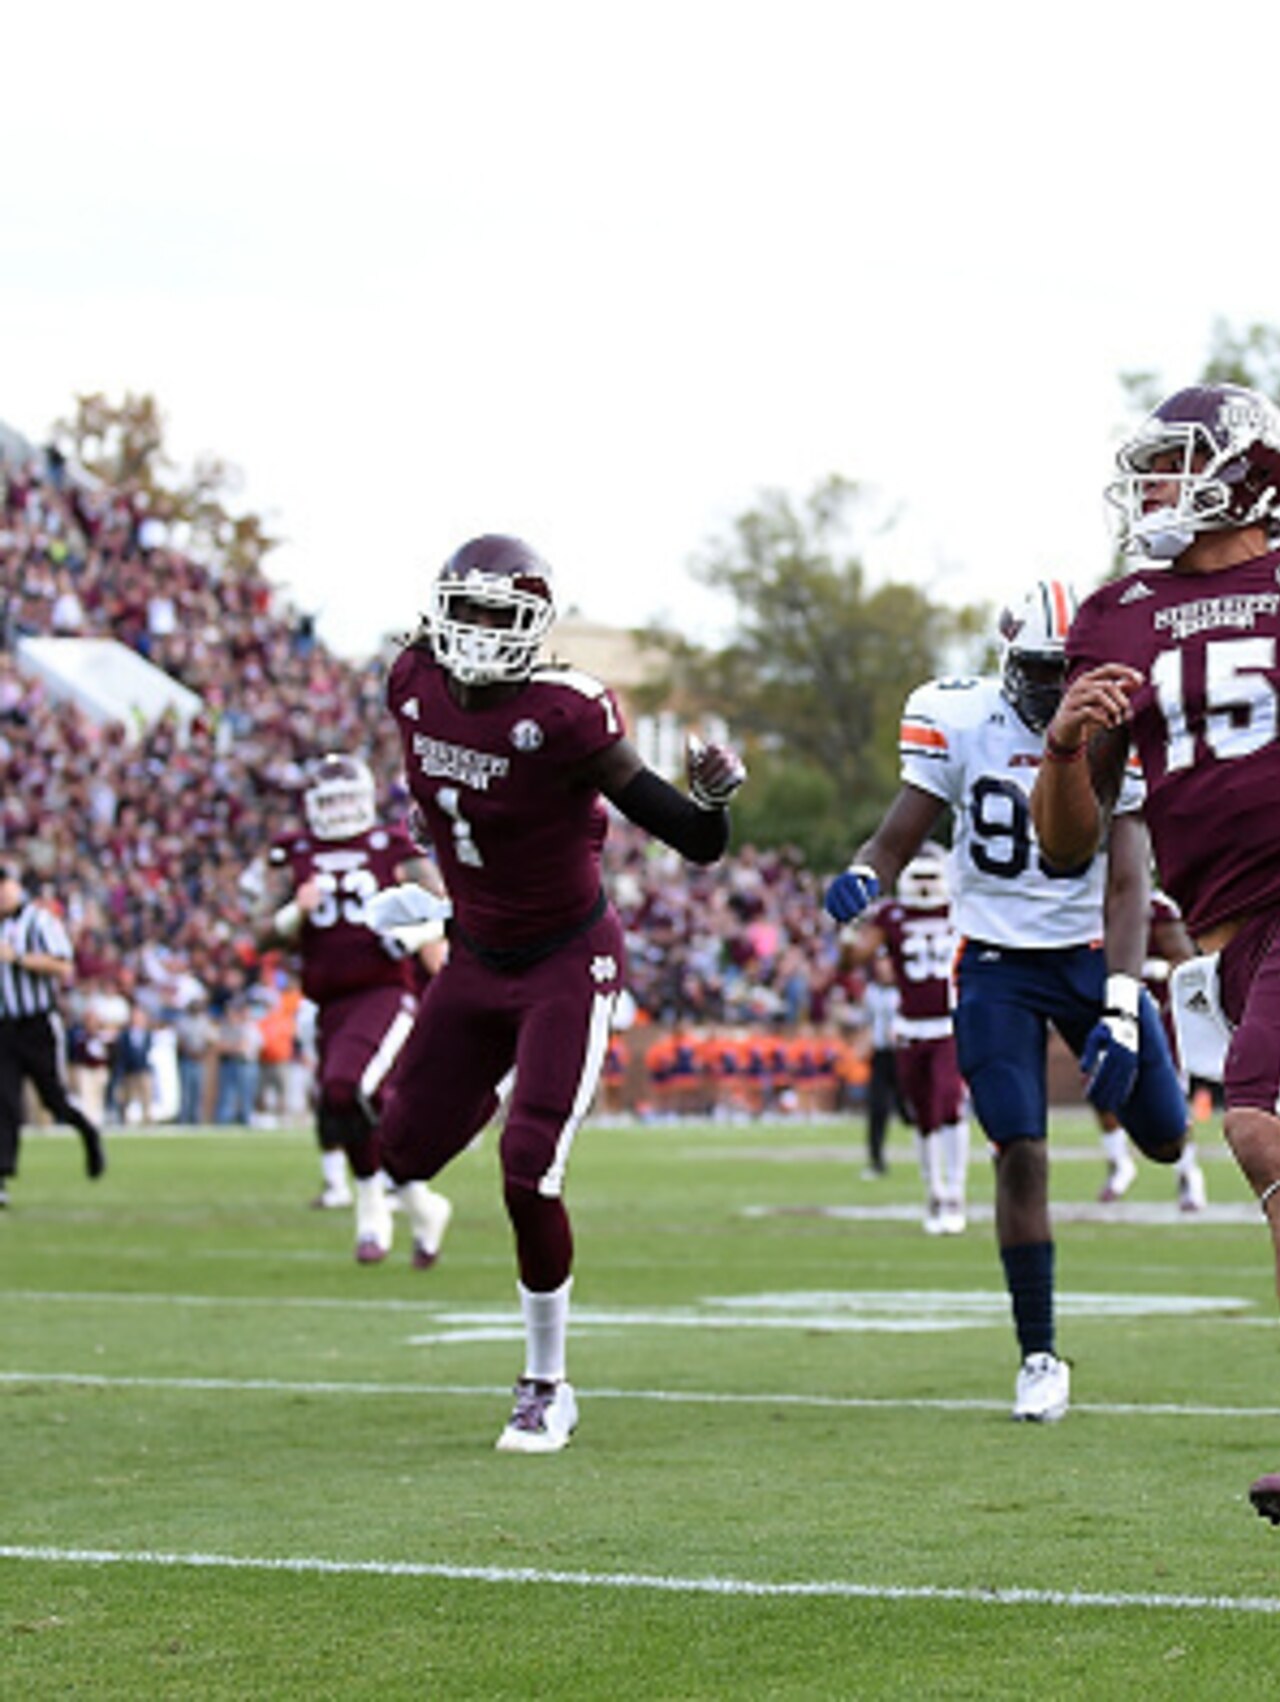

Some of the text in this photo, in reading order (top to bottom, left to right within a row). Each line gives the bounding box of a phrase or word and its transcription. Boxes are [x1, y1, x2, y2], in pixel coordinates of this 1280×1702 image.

[1151, 636, 1278, 775] 15
[435, 786, 484, 869] 1
[969, 776, 1096, 880] 9
